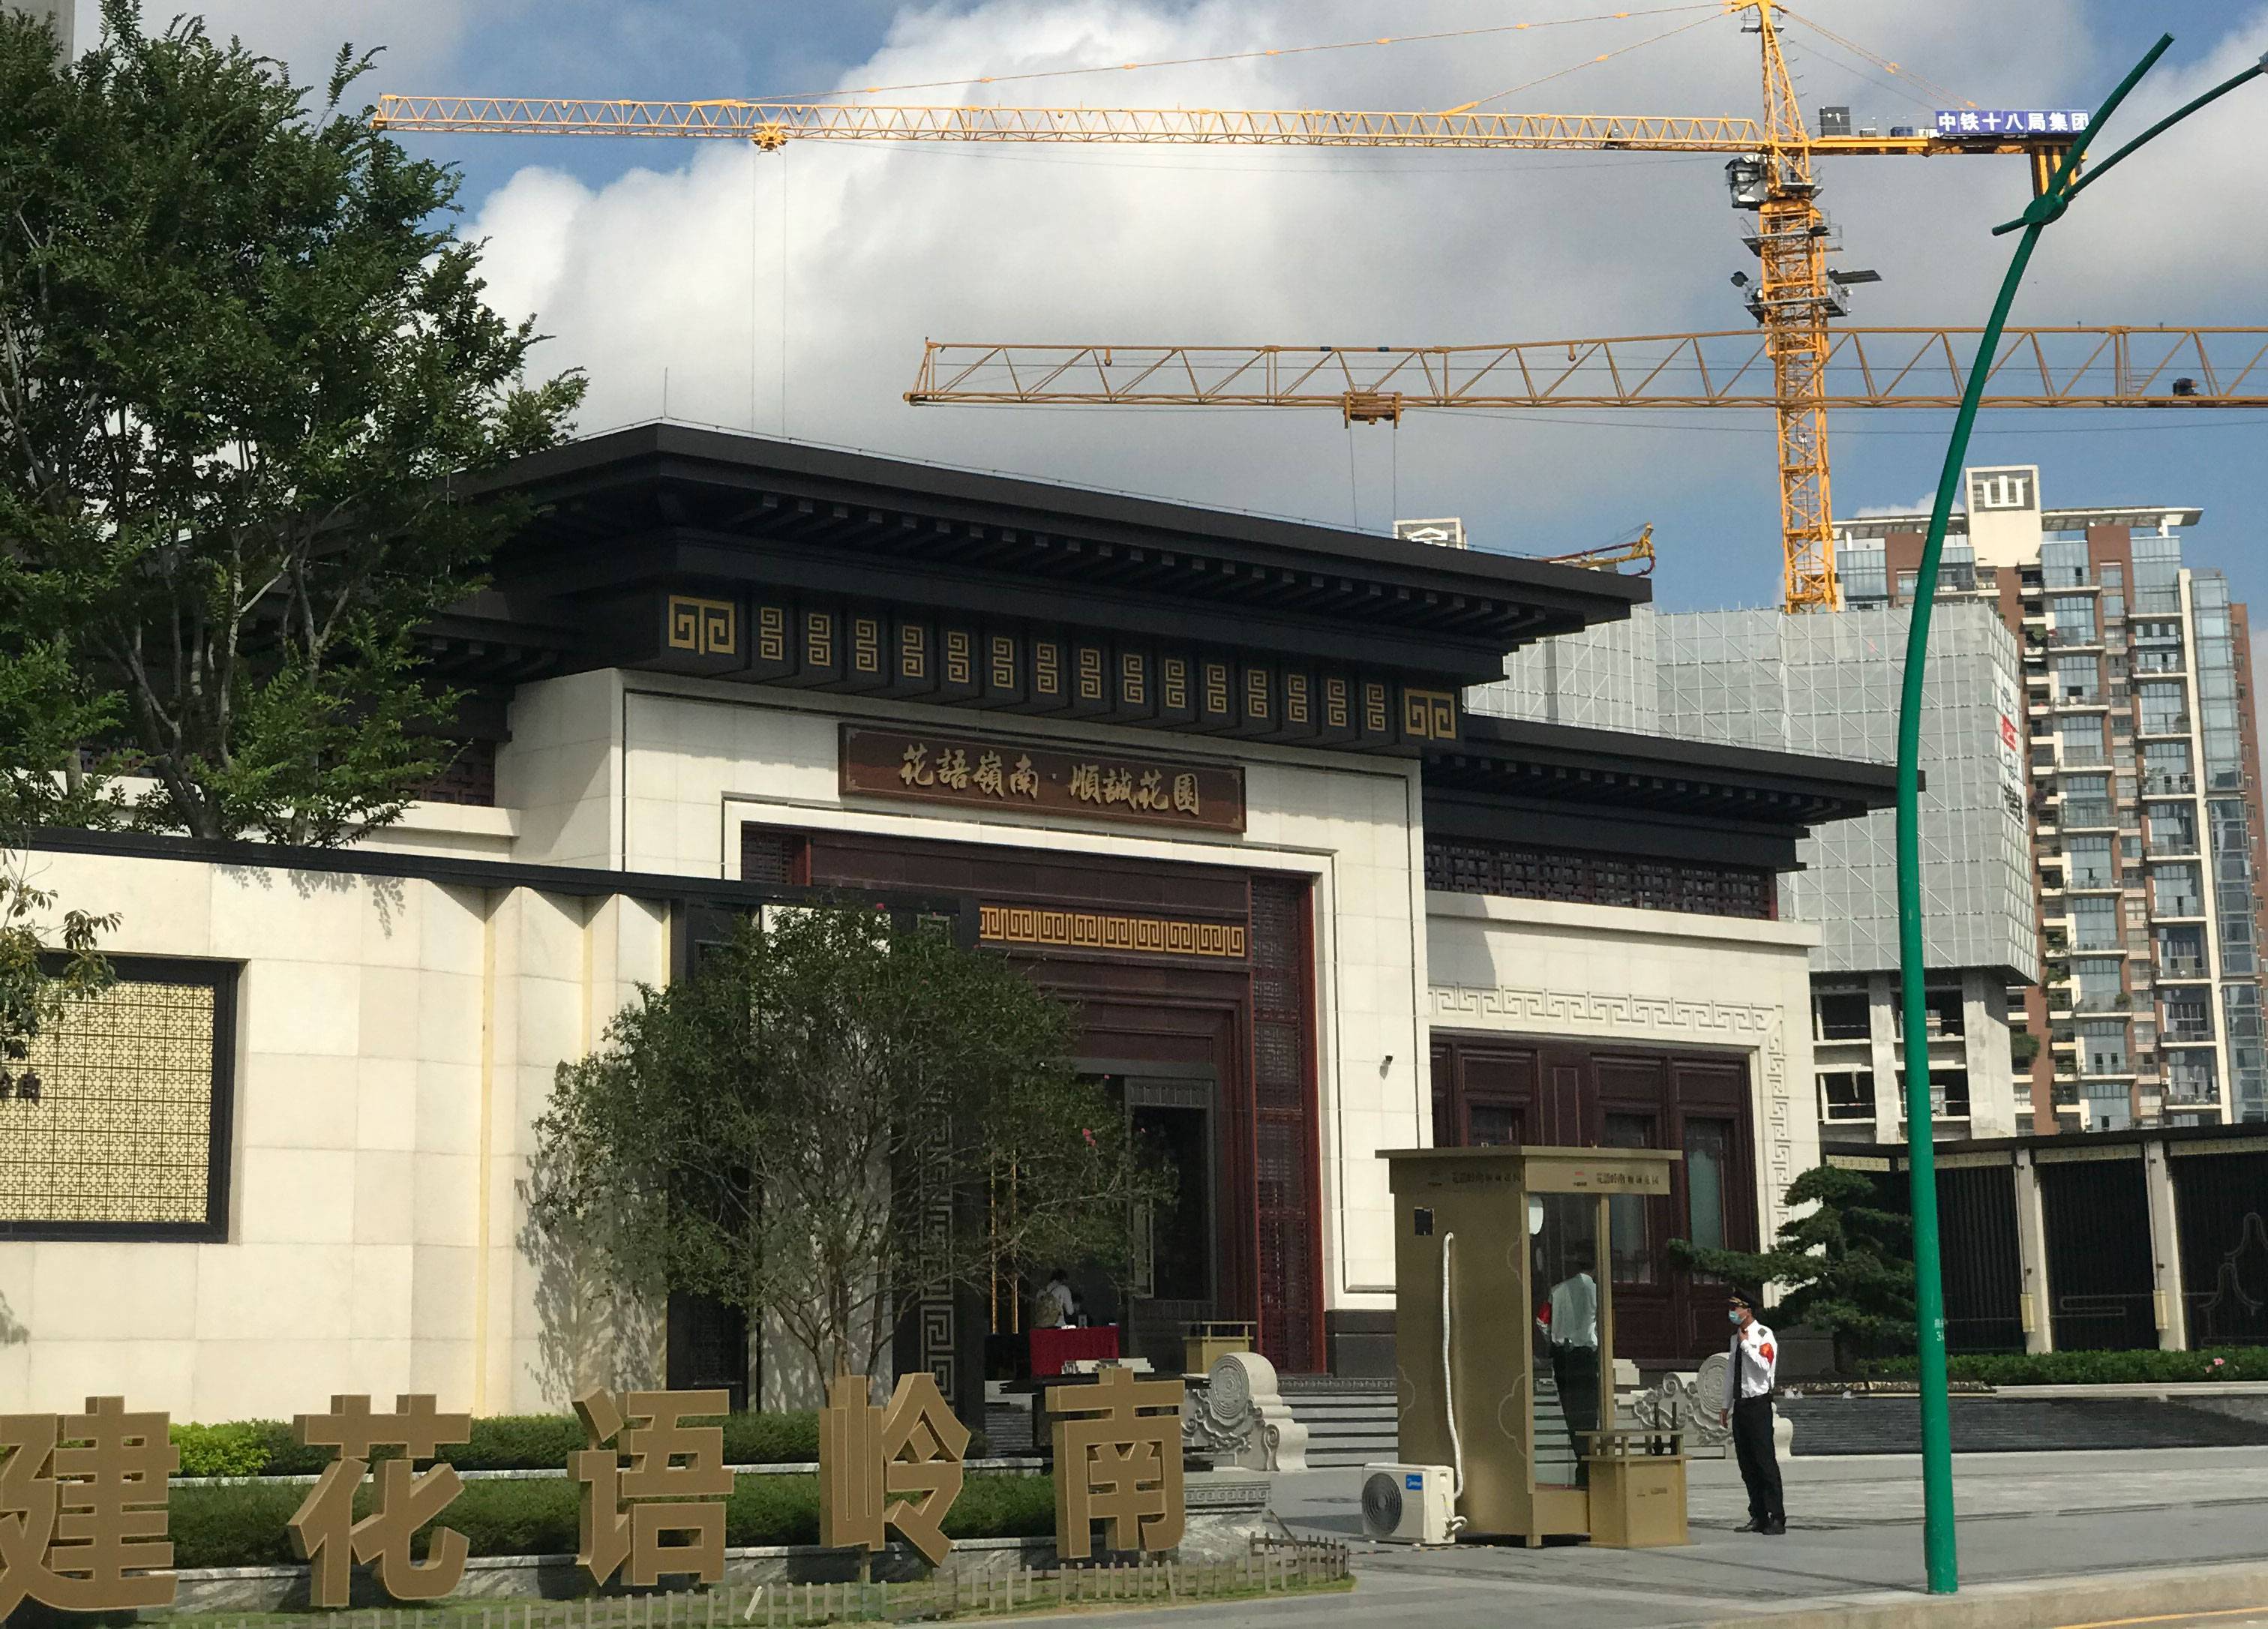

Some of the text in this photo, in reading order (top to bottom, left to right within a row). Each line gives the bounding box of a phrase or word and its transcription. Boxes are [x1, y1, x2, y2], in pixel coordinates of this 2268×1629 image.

[1938, 112, 2090, 132] 中铁十八局集团
